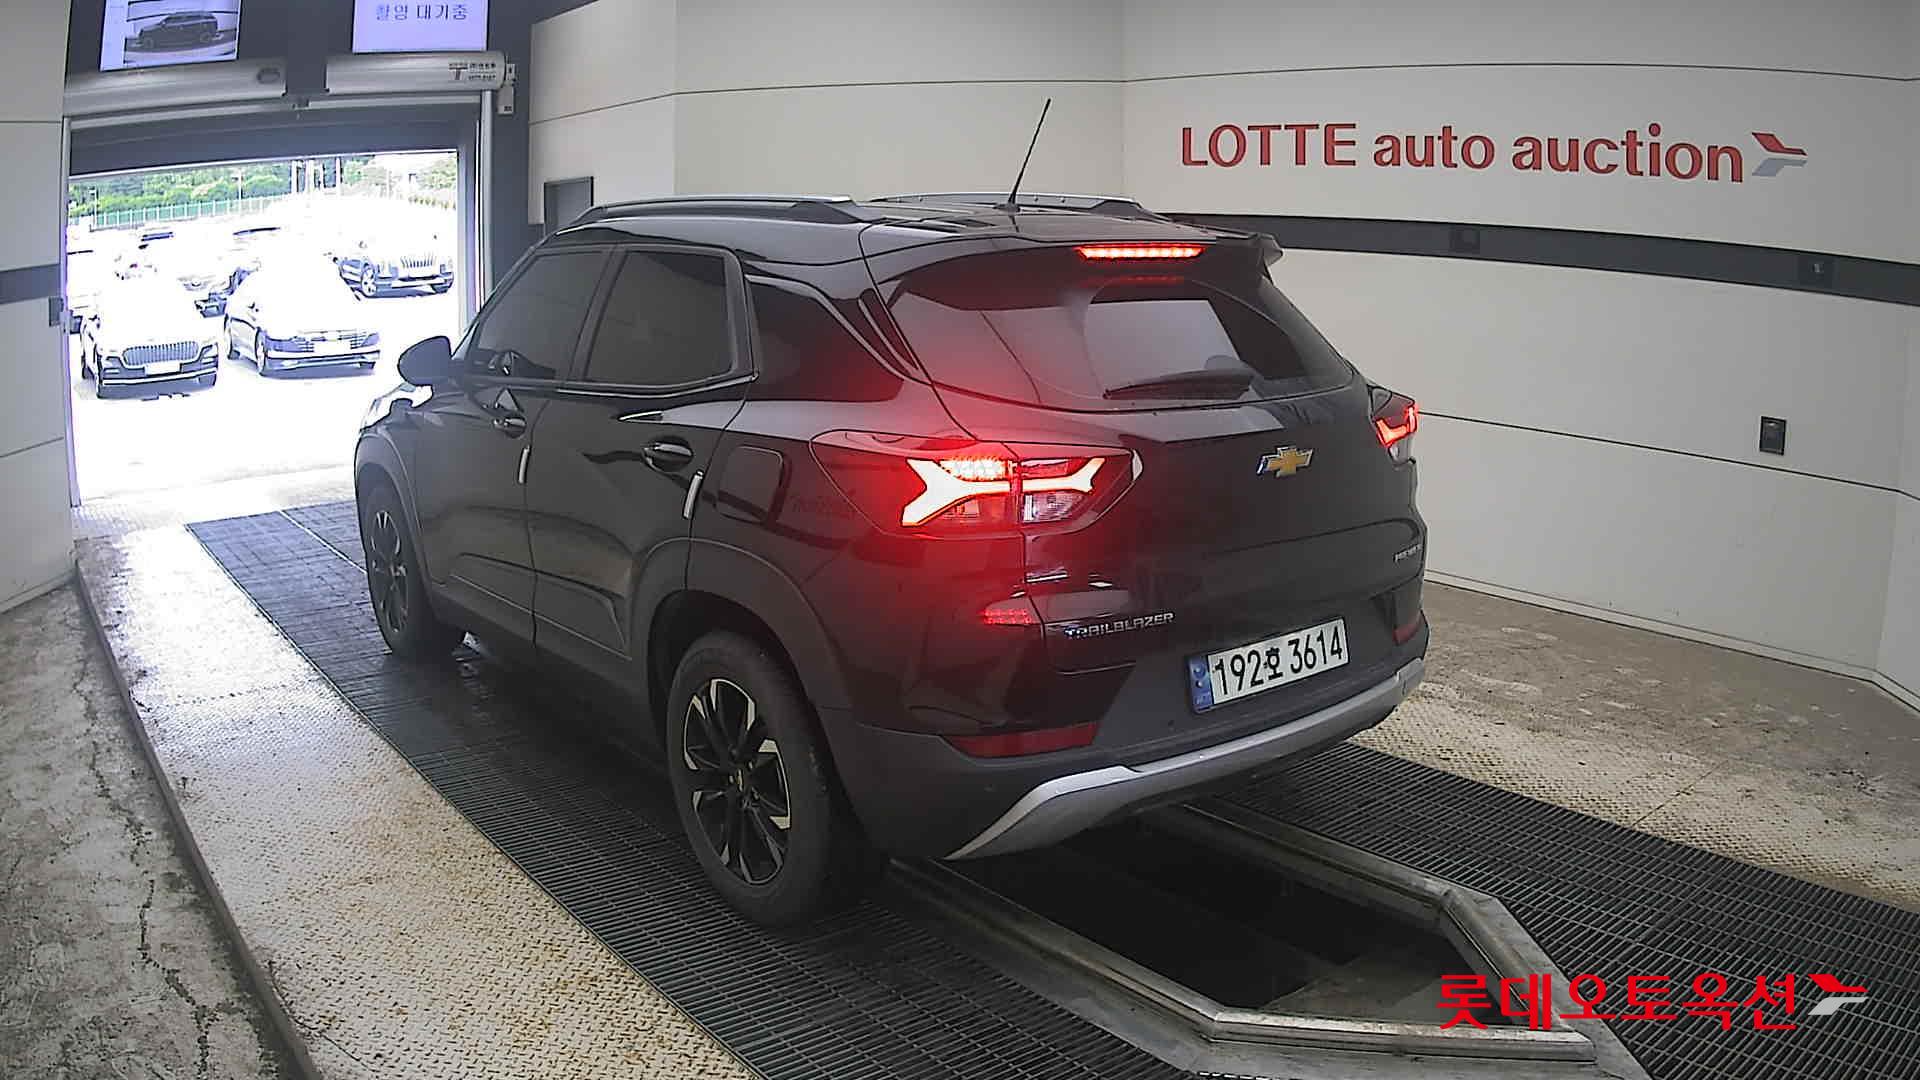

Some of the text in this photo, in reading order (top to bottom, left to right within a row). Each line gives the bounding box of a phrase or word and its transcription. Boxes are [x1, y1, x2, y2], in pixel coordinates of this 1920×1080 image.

[417, 4, 469, 21] 대기중
[1180, 123, 1744, 183] LOTTE auto auction
[1064, 611, 1175, 640] TRAILBLAZER
[1212, 625, 1343, 696] 192호 3614
